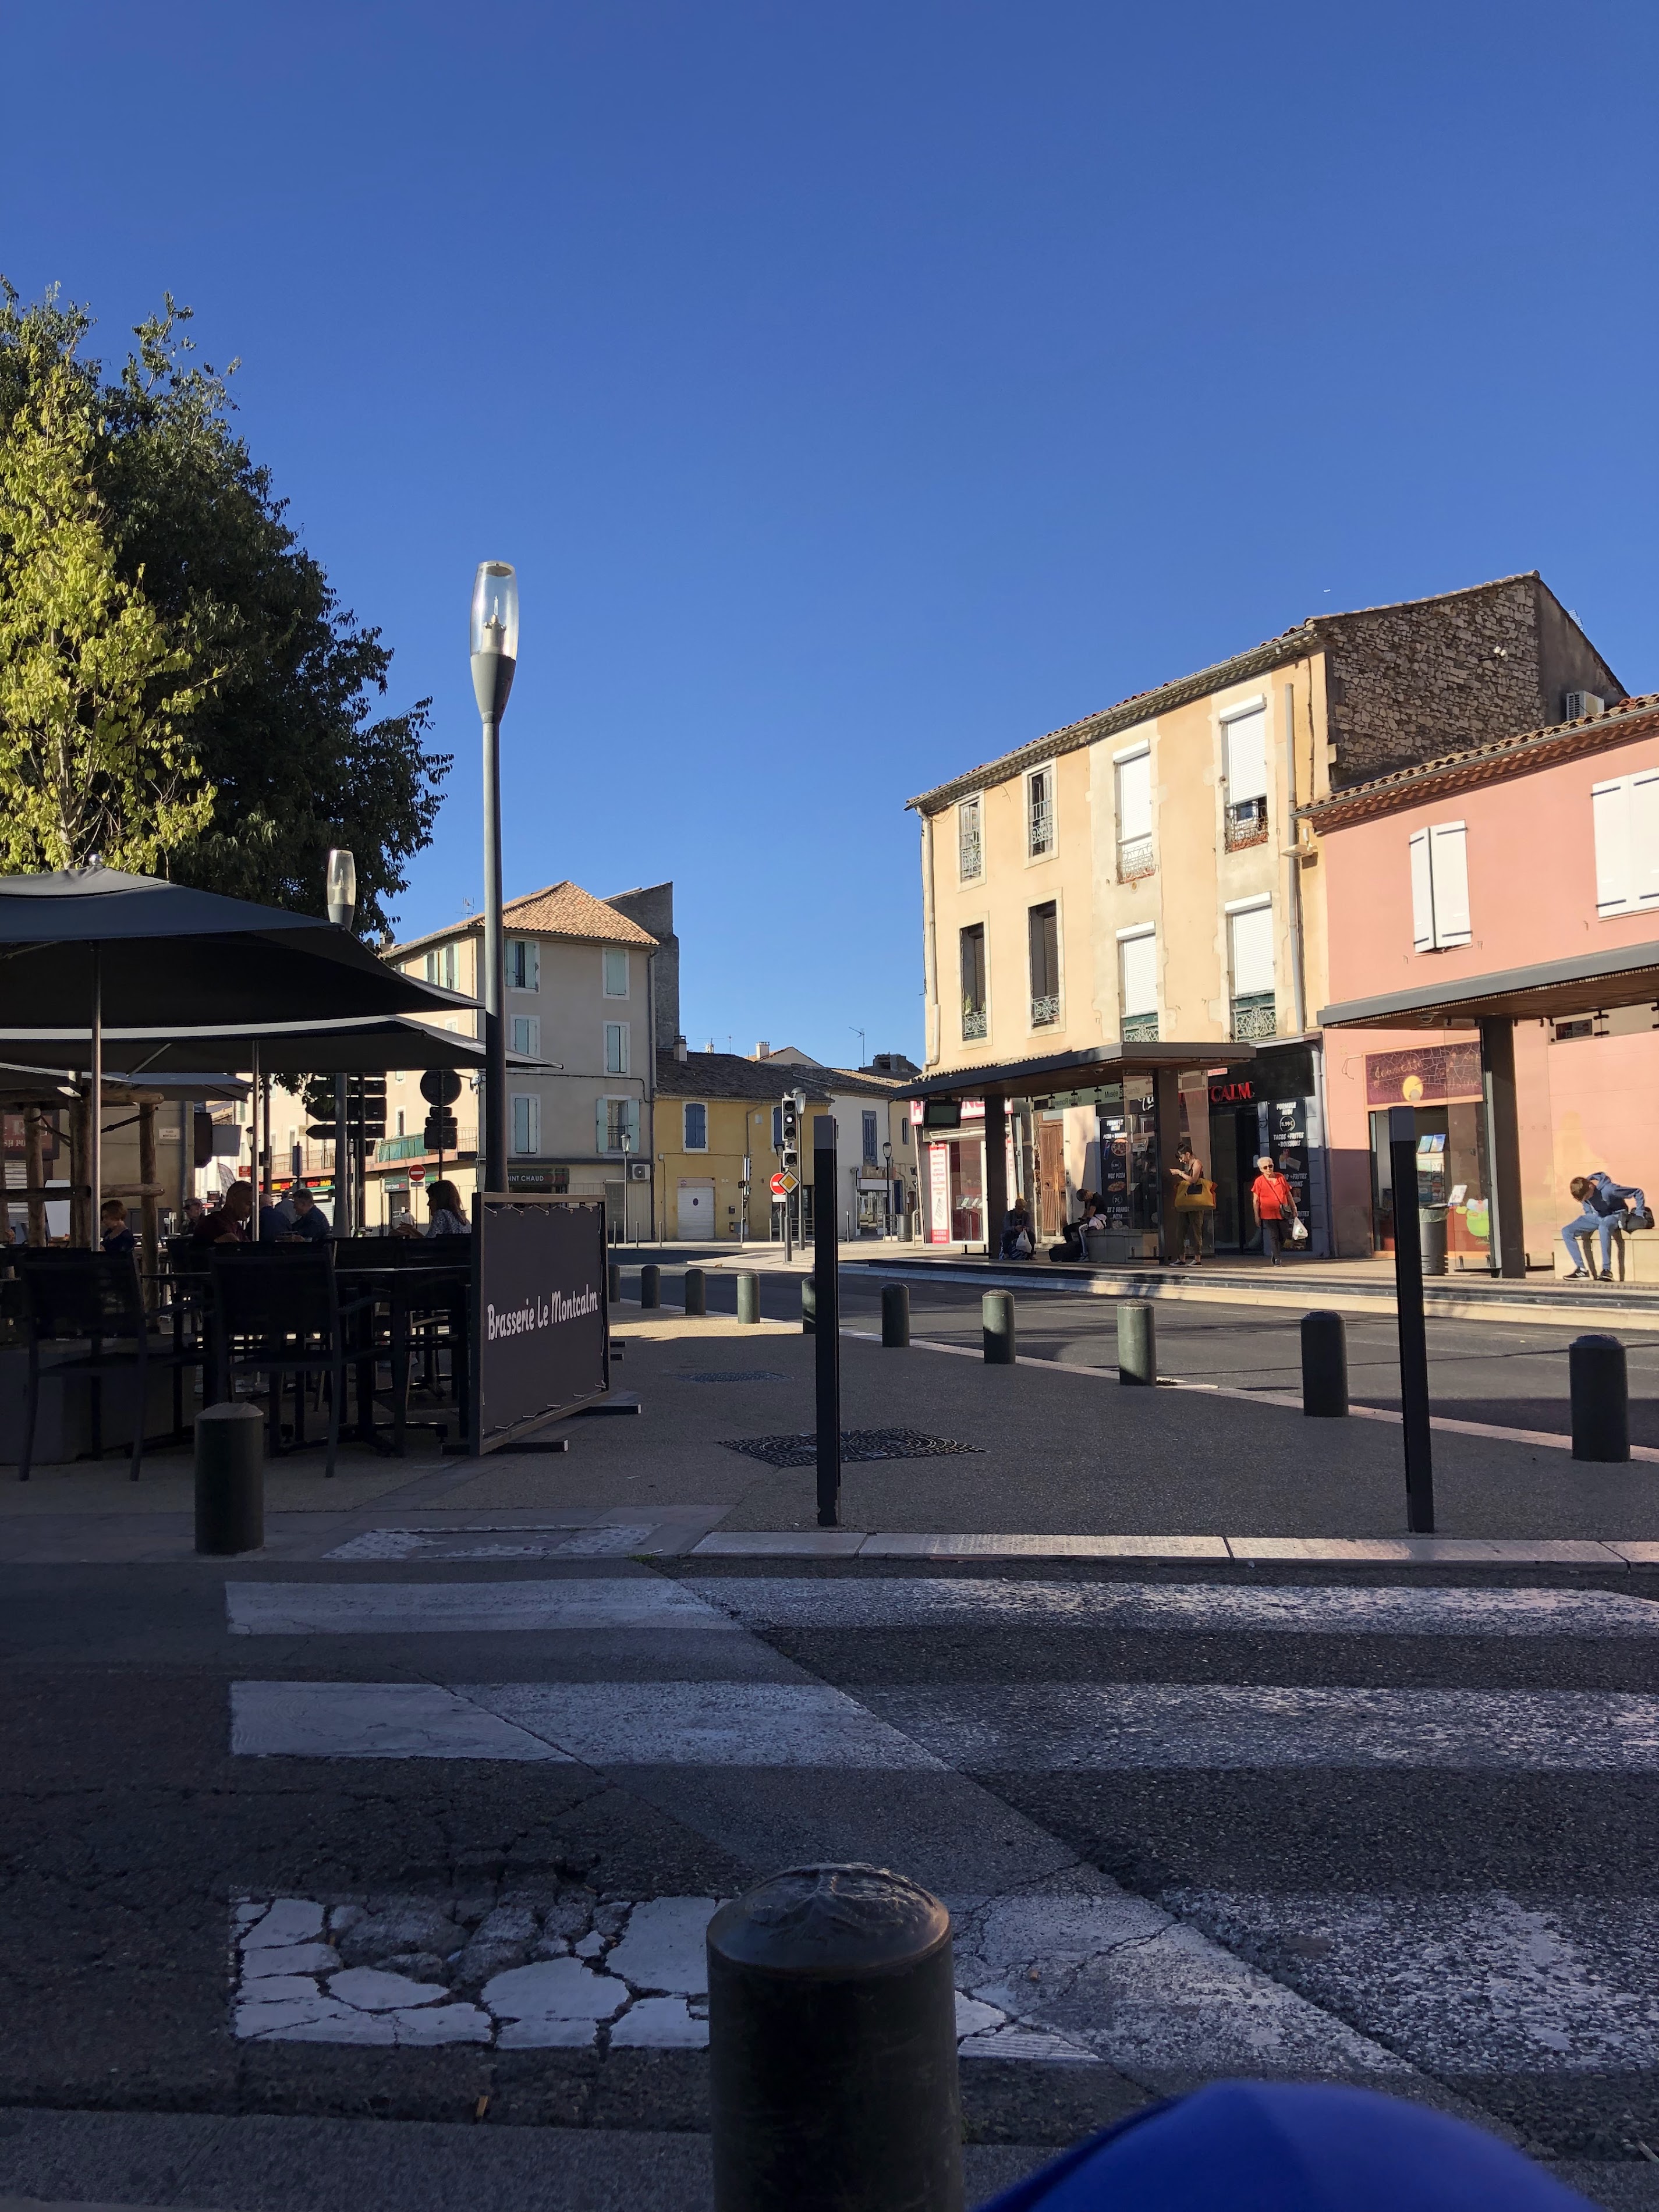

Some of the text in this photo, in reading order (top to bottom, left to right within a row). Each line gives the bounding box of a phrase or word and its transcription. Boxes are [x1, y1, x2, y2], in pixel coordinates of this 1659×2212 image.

[1104, 1090, 1119, 1098] Musée
[1277, 1101, 1297, 1110] FORMULE
[487, 1284, 598, 1340] Brasserie Le Montcalm
